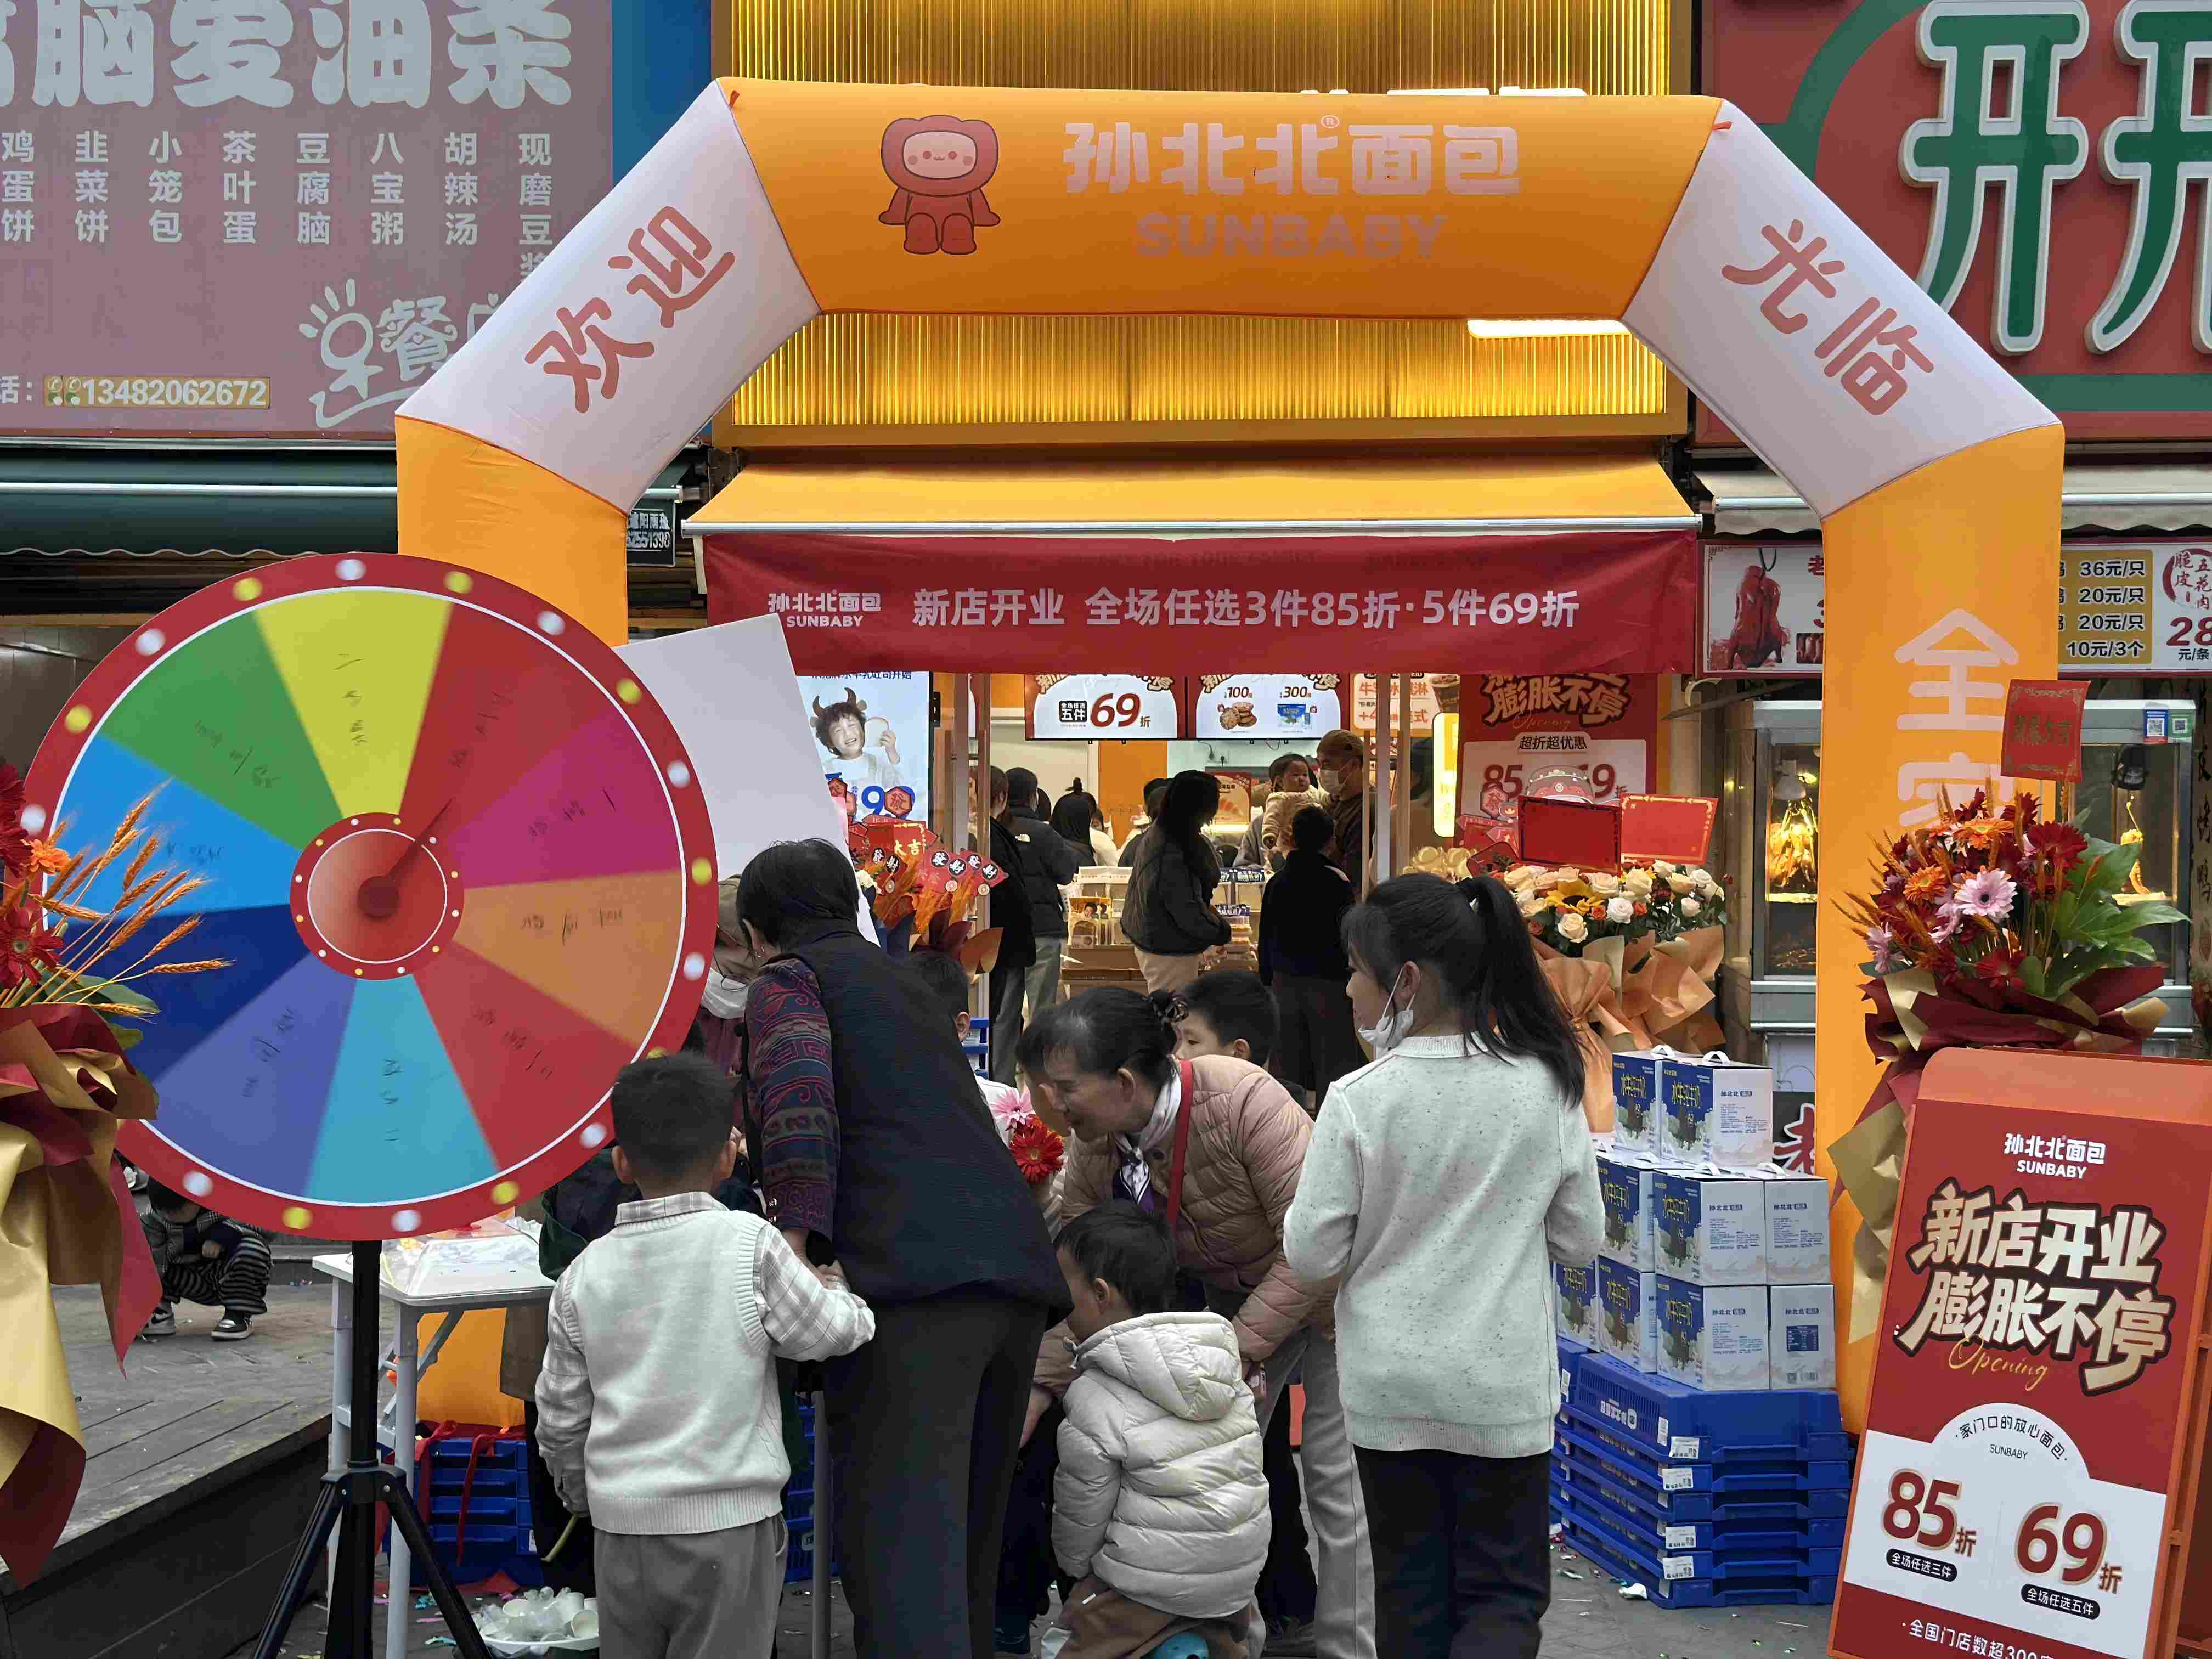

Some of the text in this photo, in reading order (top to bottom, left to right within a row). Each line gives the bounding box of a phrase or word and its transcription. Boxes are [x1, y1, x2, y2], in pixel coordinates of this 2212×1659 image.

[0, 0, 572, 108] 脑爱油条
[1063, 122, 1519, 195] 孙北北面包
[2, 131, 35, 244] 鸡蛋饼
[75, 131, 109, 244] 韭菜饼
[149, 131, 182, 244] 小笼包
[223, 131, 257, 244] 茶叶蛋
[297, 132, 330, 244] 豆腐脑
[370, 132, 404, 245] 八宝粥
[444, 132, 478, 245] 胡辣汤
[1136, 213, 1448, 259] SUNBABY
[525, 206, 736, 413] 欢迎
[1721, 219, 1935, 416] 光临
[299, 278, 499, 400] 早餐
[83, 379, 267, 405] 13482062672
[2080, 560, 2145, 577] 36元/只
[768, 592, 882, 613] 孙北北面包
[912, 588, 1065, 627] 新店开业
[2079, 587, 2145, 603] 20元/只
[786, 616, 864, 628] SUNBABY
[2078, 614, 2144, 630] 20元/只
[2067, 640, 2145, 657] 10元/3个
[1483, 676, 1628, 725] 膨胀不停
[1518, 736, 1587, 750] 超折超优惠
[2004, 1133, 2106, 1164] 孙北北面包
[2016, 1160, 2087, 1179] SUNBABY
[1910, 1183, 2163, 1284] 新店开业
[1897, 1271, 2172, 1392] 膨胀不停
[1948, 1333, 2049, 1391] Opening
[1989, 1443, 2028, 1460] SUNBABY
[1891, 1551, 1953, 1579] 全场任选三件
[2027, 1587, 2094, 1616] 全场任选五件
